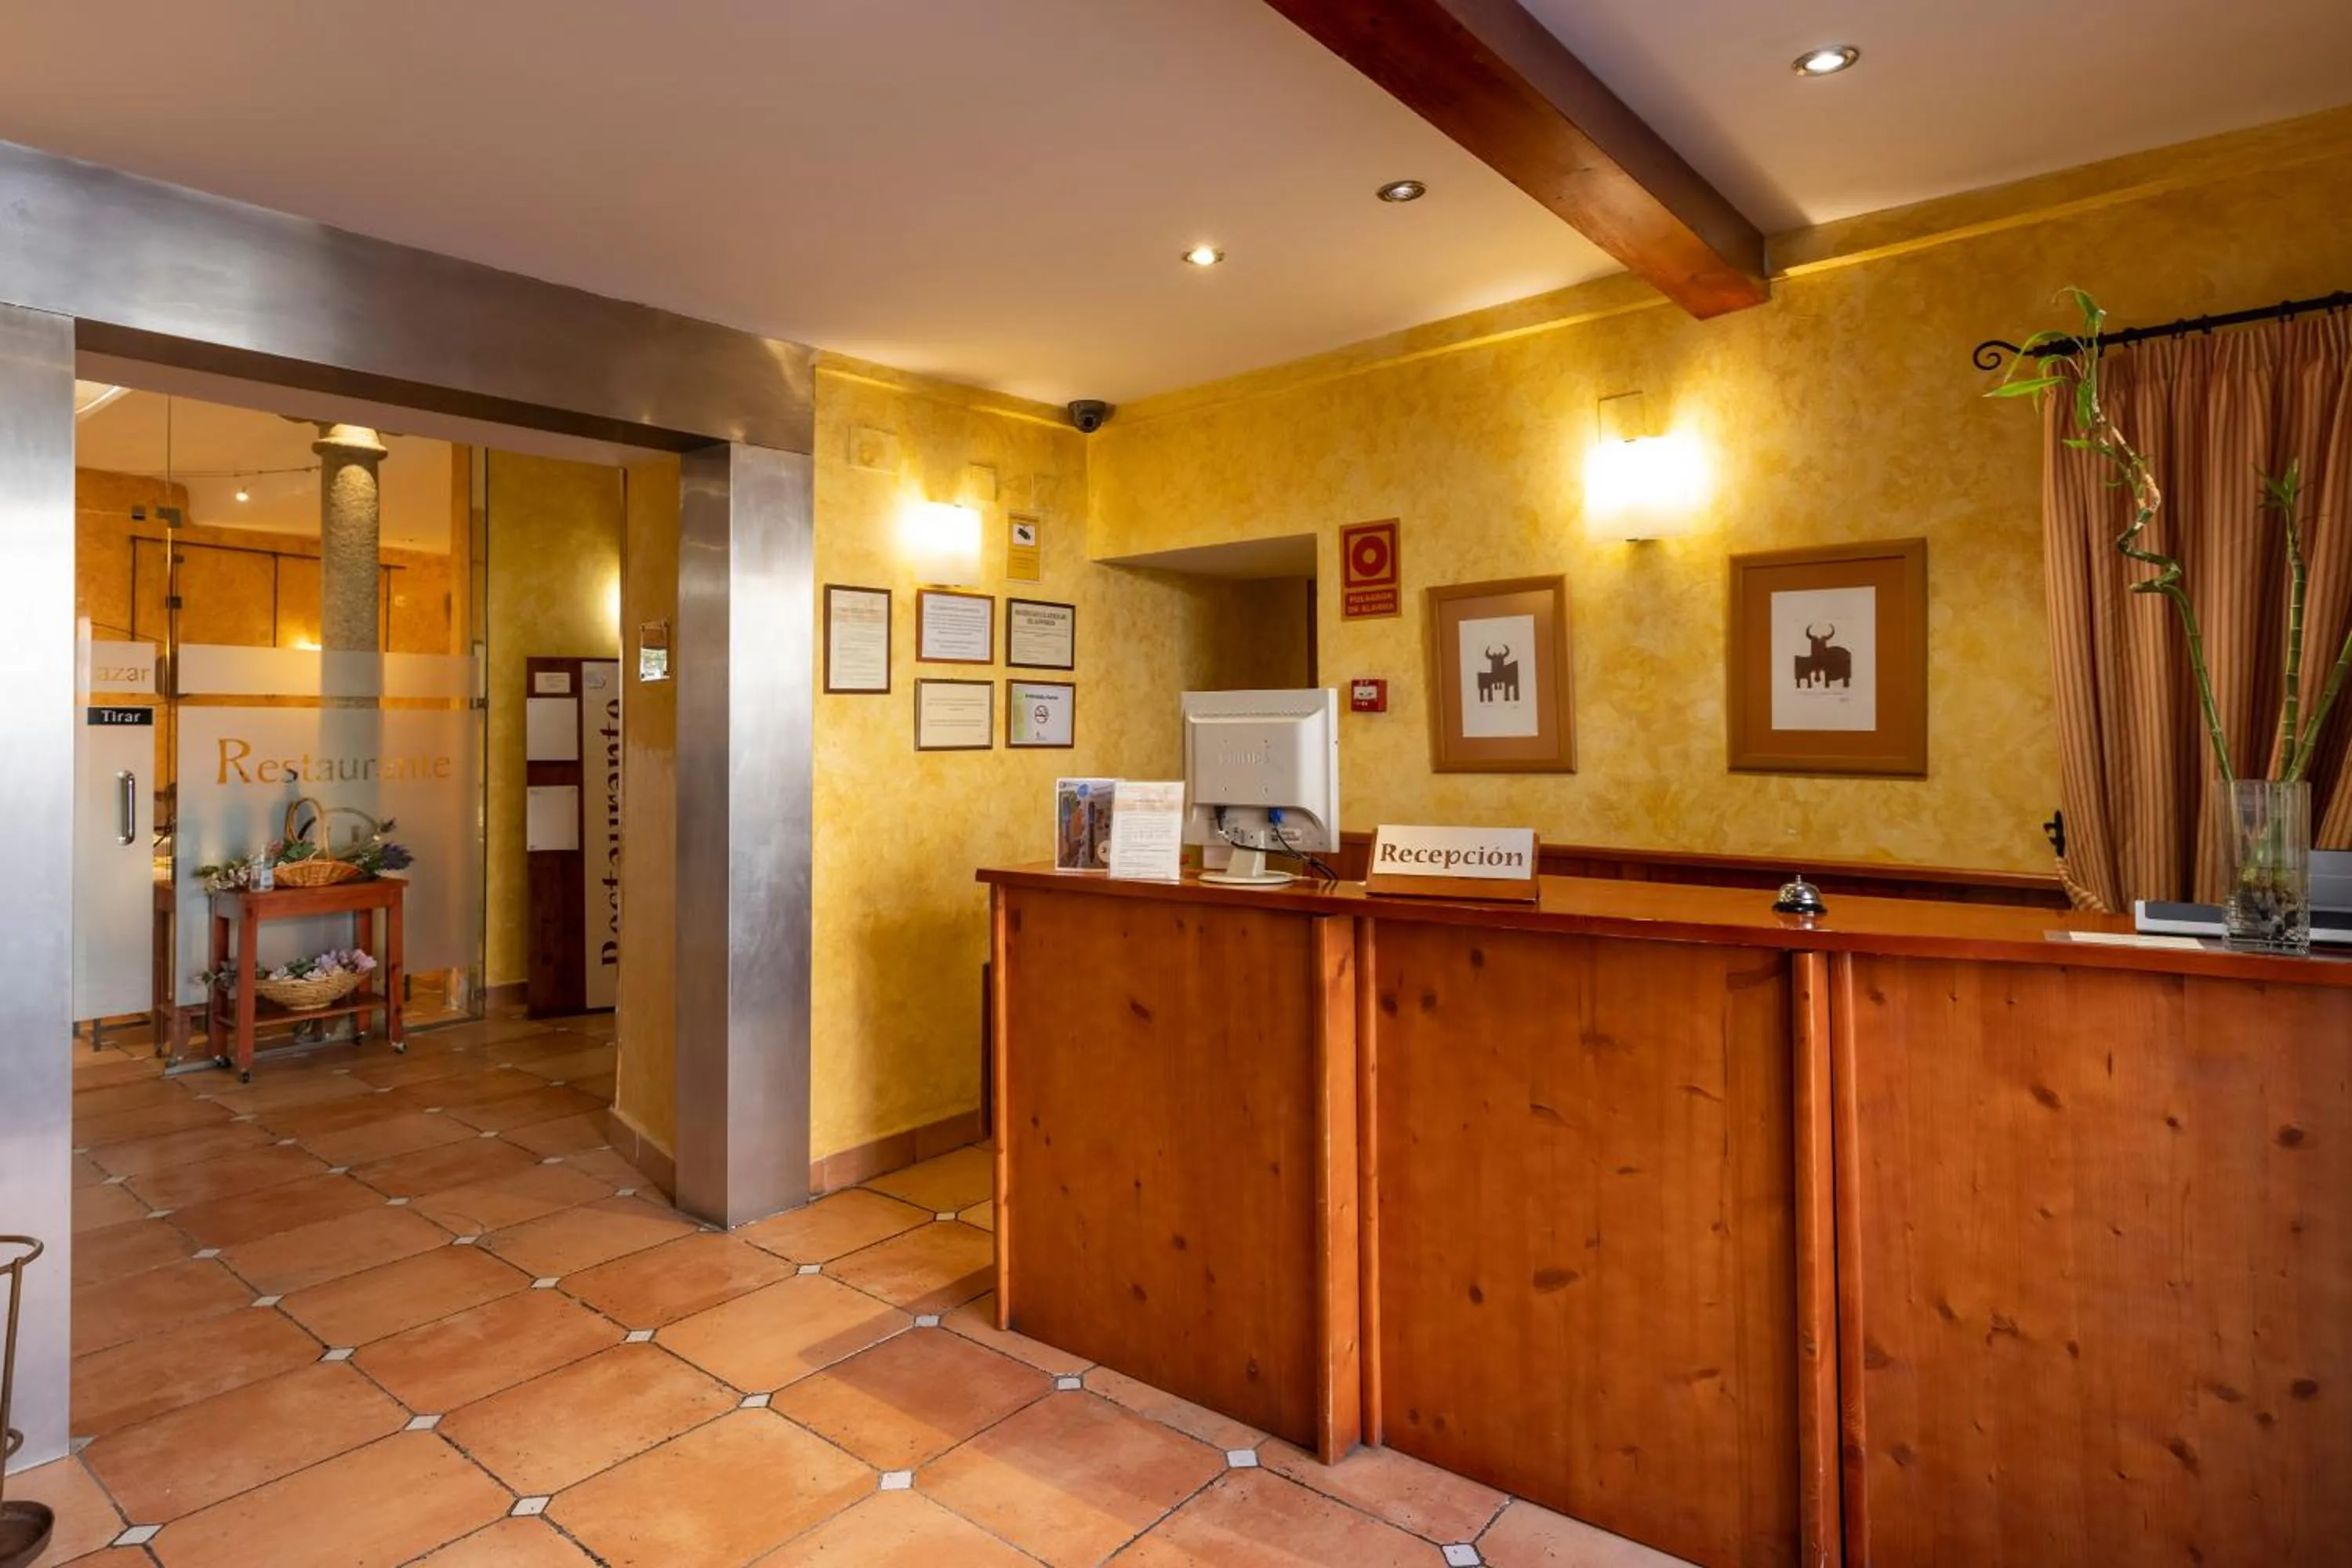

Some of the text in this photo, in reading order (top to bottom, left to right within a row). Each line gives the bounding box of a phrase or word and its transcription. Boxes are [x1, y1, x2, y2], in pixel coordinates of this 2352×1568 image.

[101, 710, 141, 722] Tirar
[216, 738, 451, 784] Restaurante
[1380, 842, 1523, 869] Recepción
